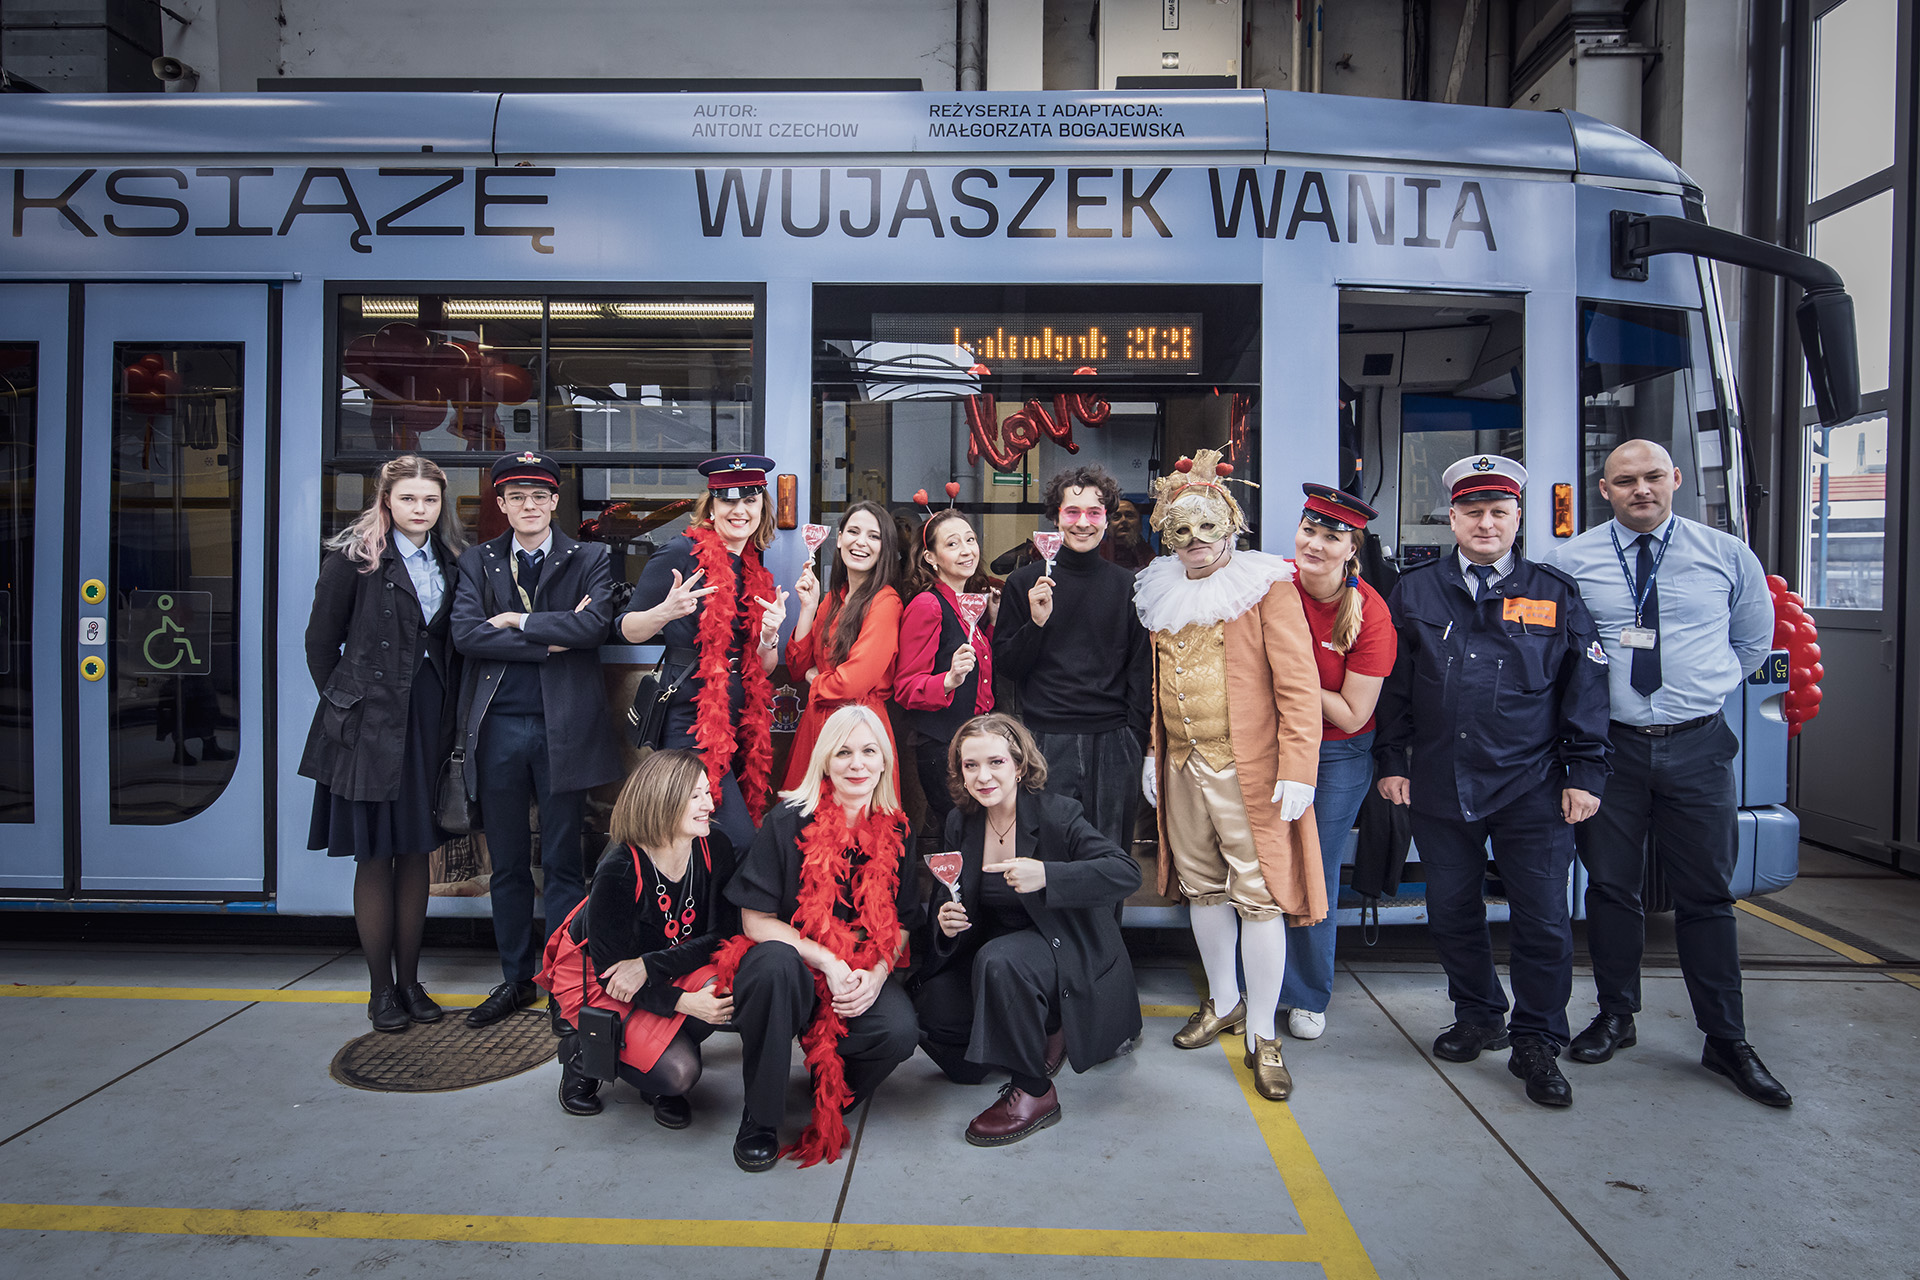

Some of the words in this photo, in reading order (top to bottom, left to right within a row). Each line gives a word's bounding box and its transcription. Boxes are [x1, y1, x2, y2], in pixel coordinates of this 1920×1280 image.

[693, 104, 758, 118] AUTOR:
[929, 102, 1032, 118] REŻYSERIA
[1036, 104, 1047, 118] I
[1052, 104, 1164, 118] ADAPTACJA:
[692, 123, 763, 138] ANTONI
[768, 123, 860, 138] CZECHOW
[928, 123, 1053, 138] MAŁGORZATA
[1059, 123, 1185, 138] BOGAJEWSKA
[12, 145, 556, 254] KSIĄŻĘ
[694, 167, 1174, 238] WUJASZEK
[1207, 167, 1498, 252] WANIA
